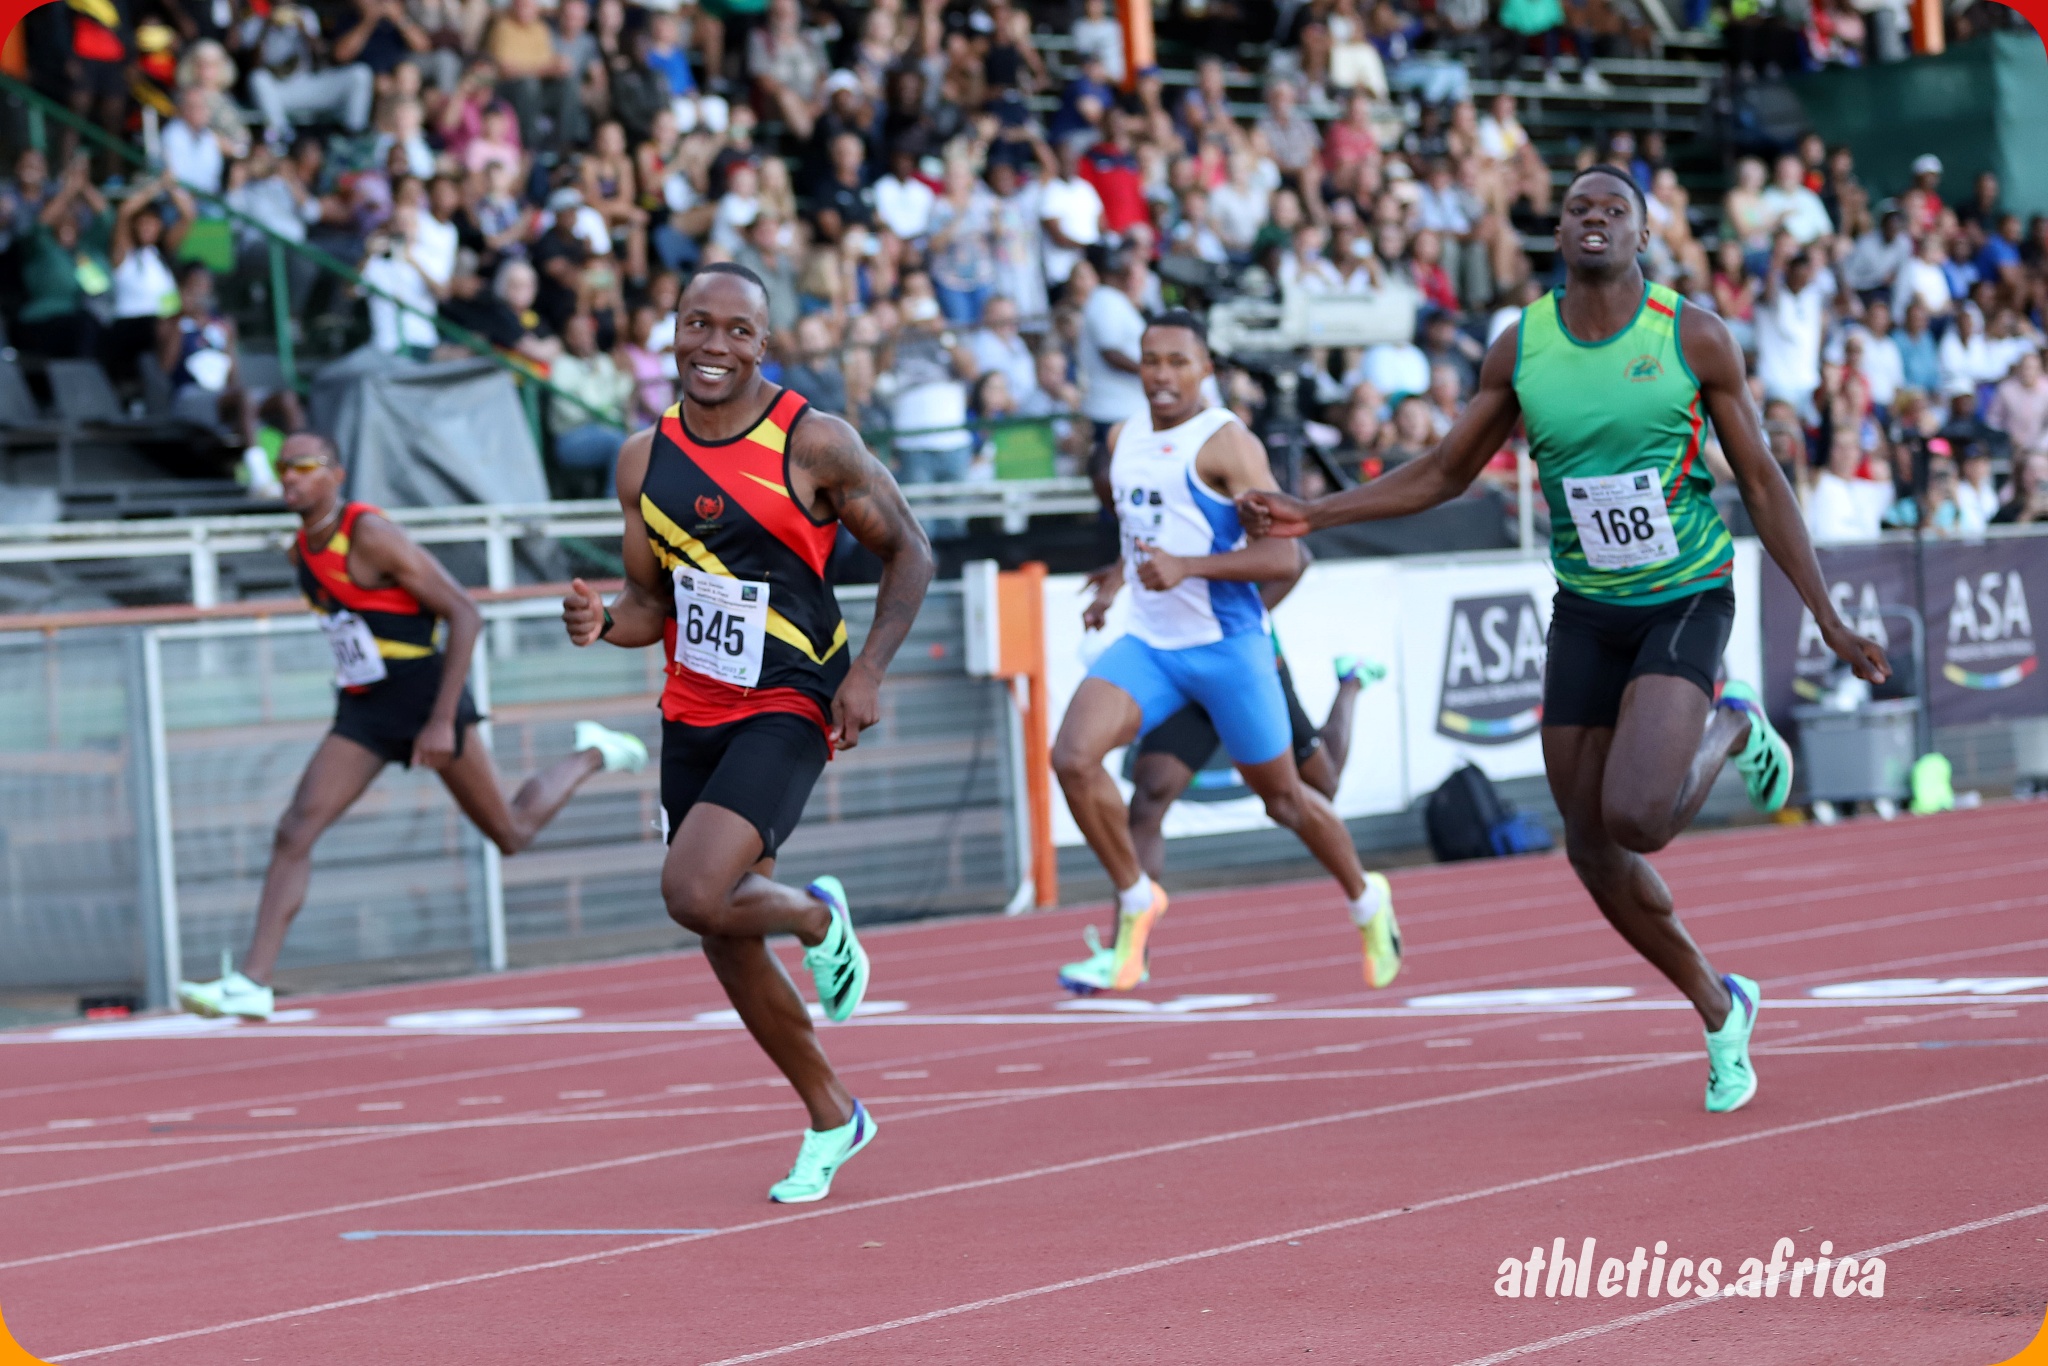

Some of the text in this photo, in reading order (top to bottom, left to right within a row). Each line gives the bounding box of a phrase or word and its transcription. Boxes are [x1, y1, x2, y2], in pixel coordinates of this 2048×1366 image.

[1591, 506, 1654, 545] 168
[686, 603, 745, 656] 645
[1948, 569, 2032, 642] ASA
[1446, 605, 1547, 687] ASA
